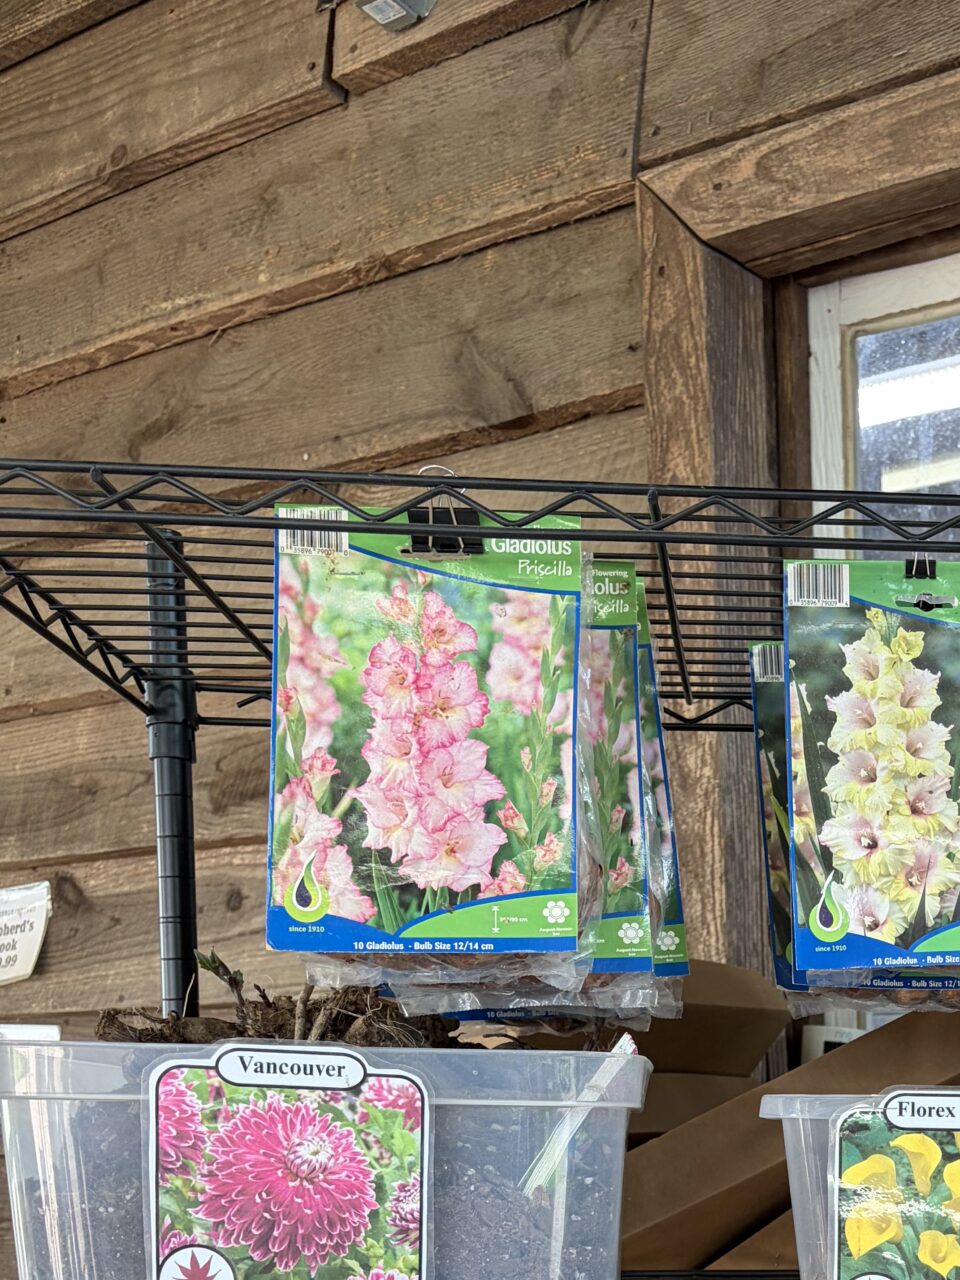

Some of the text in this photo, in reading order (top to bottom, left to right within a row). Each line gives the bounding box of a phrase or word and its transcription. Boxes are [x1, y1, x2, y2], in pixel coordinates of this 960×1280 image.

[491, 537, 573, 556] Gladiolus
[518, 559, 573, 577] Priscilla
[308, 925, 325, 933] 1910
[353, 941, 364, 949] 10
[366, 941, 404, 950] Gladiolus
[414, 941, 432, 950] Bulb
[435, 941, 451, 950] Size
[453, 941, 479, 951] 12/14
[873, 958, 883, 966] 10
[884, 957, 918, 965] Gladiolus
[926, 956, 944, 964] Bulb
[945, 955, 960, 963] Size
[872, 979, 904, 987] Gladiolus
[912, 979, 927, 987] Bulb
[929, 979, 942, 987] Size
[237, 1055, 346, 1078] Vancouver
[897, 1101, 956, 1119] Florex
